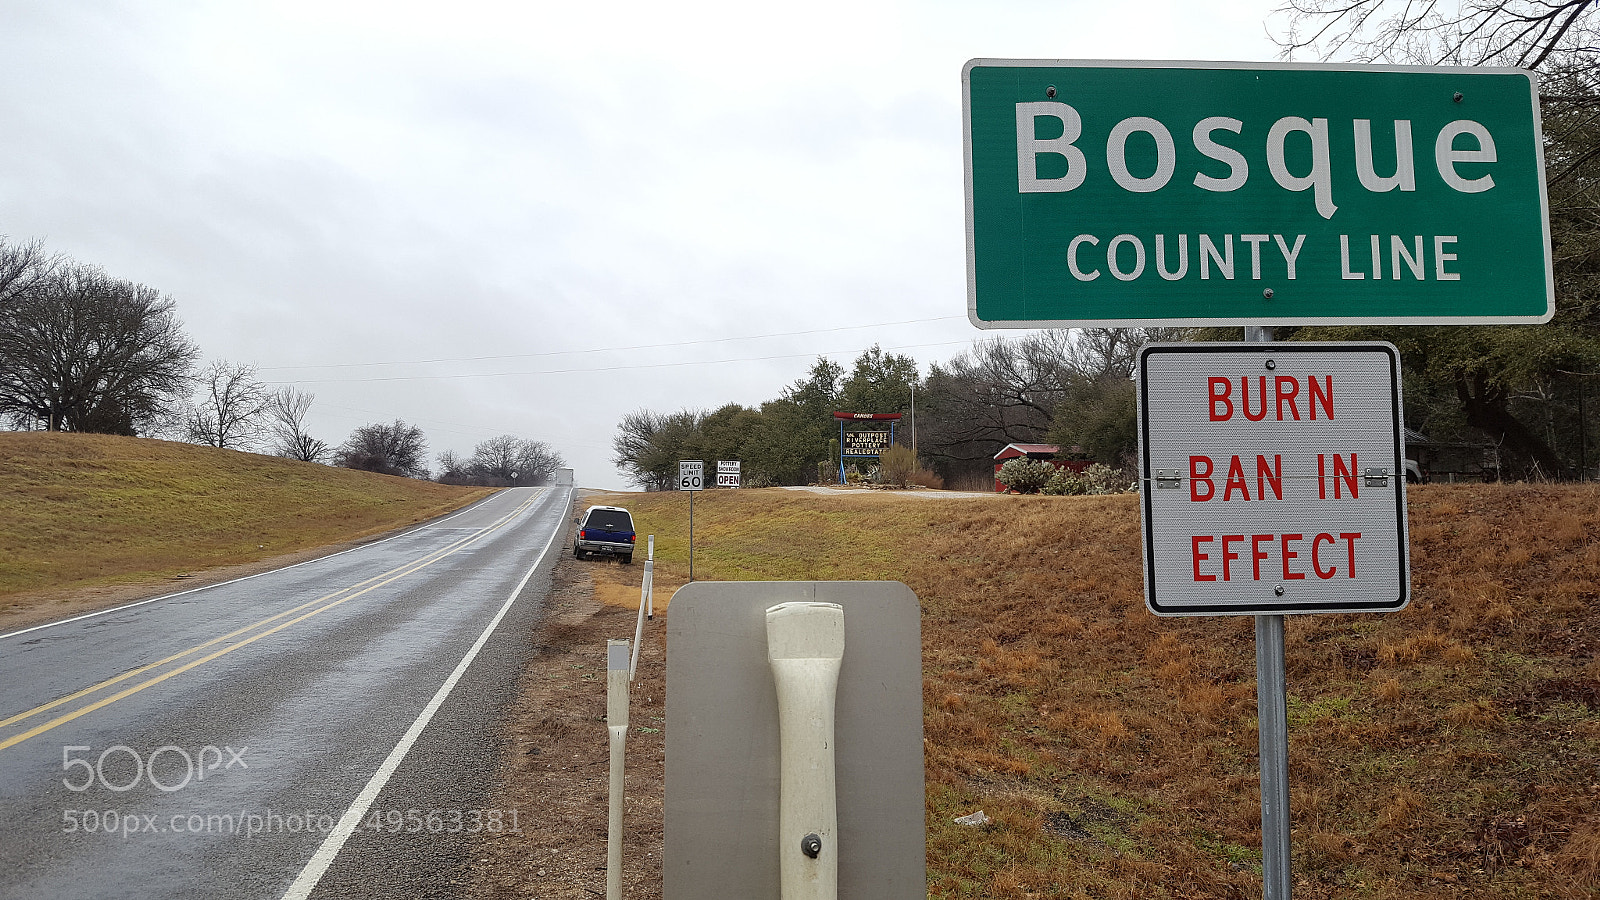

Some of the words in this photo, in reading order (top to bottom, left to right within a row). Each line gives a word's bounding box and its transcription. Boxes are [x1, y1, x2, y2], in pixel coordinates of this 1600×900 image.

[1015, 100, 1498, 220] Bosque
[1066, 233, 1307, 282] COUNTY
[1340, 234, 1462, 281] LINE
[1207, 375, 1335, 422] BURN
[682, 477, 700, 487] 60
[719, 476, 738, 484] OPEN
[1189, 454, 1283, 502] BAN
[1317, 453, 1359, 500] IN
[1191, 532, 1362, 582] EFFECT
